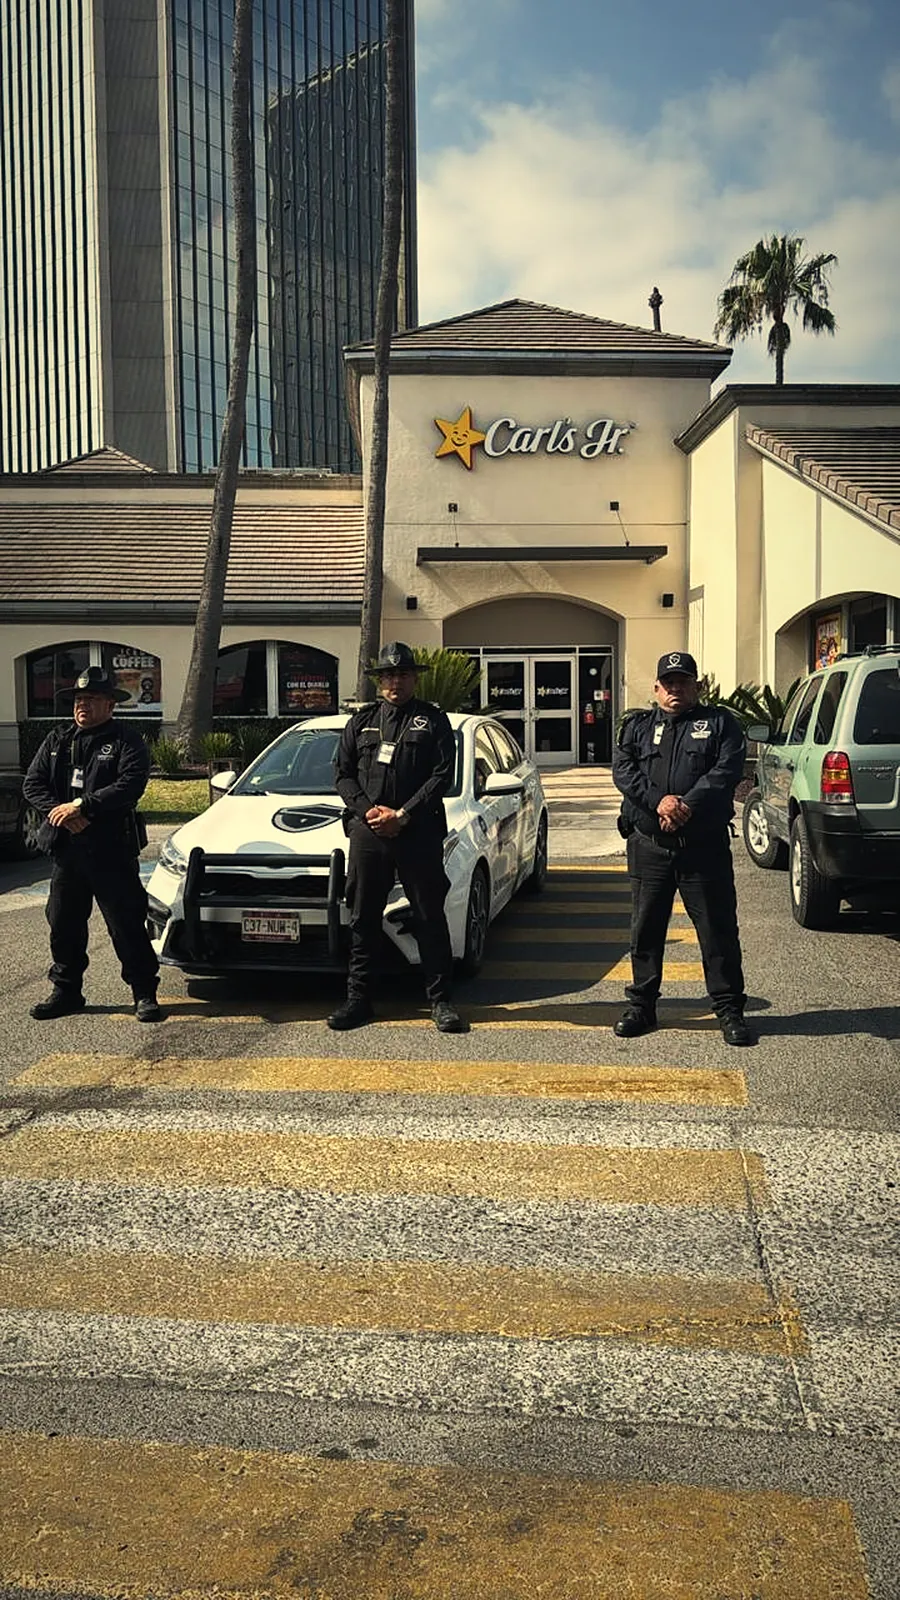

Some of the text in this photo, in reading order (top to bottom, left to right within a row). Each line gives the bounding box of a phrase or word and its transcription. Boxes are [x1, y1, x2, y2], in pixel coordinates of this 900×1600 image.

[483, 417, 630, 459] Carl's Jr.
[112, 656, 155, 668] COFFEE
